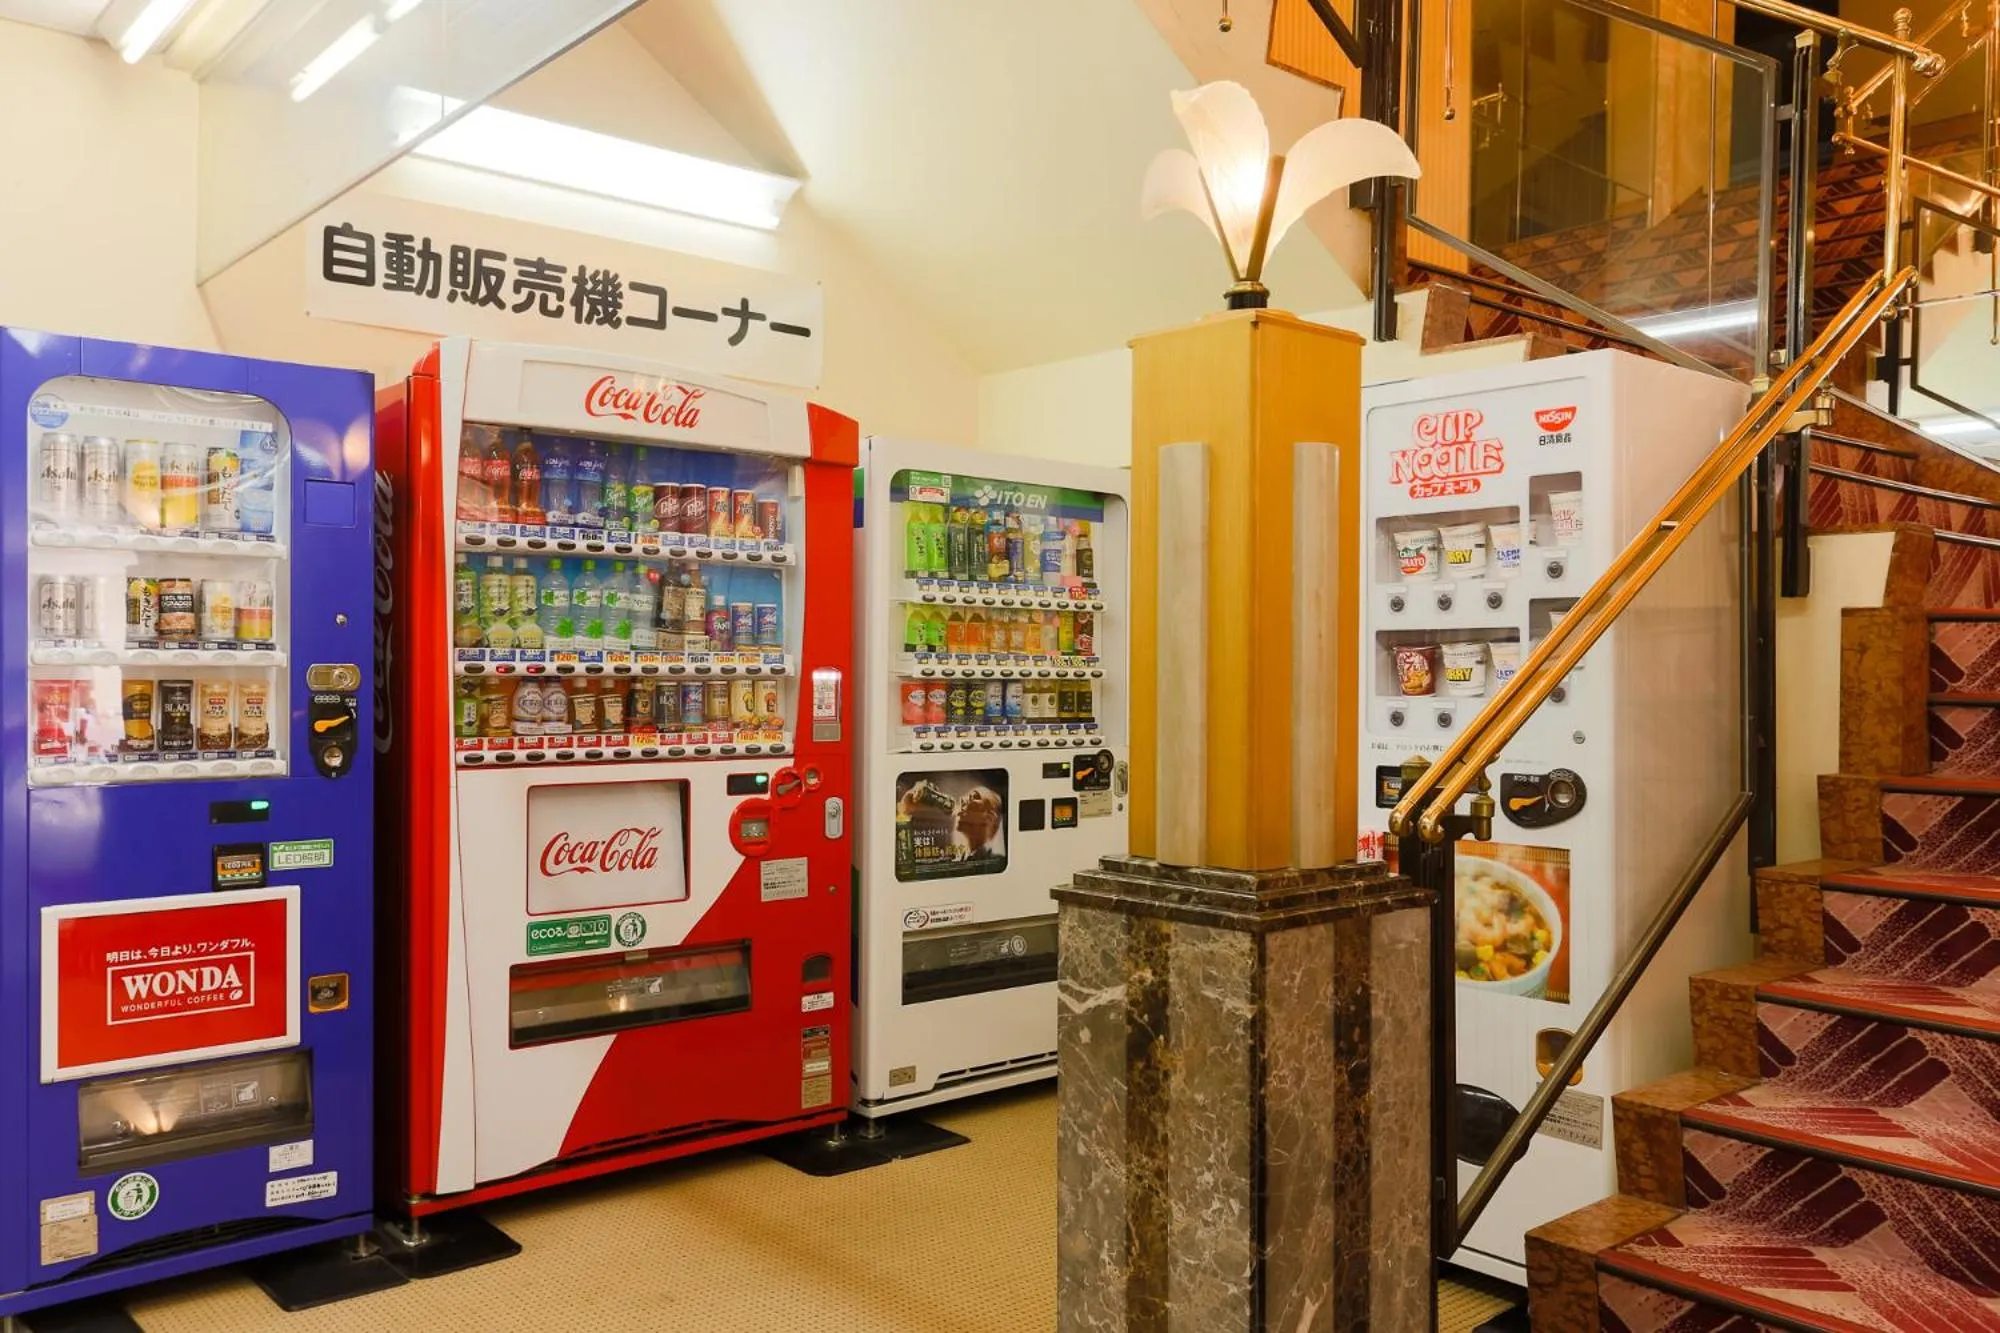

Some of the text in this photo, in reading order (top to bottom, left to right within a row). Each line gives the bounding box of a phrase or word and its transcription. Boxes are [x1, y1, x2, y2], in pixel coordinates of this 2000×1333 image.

[322, 222, 812, 347] 自動販売機コーナー
[584, 374, 707, 430] Coca-Cola
[1412, 408, 1484, 449] CUP
[1538, 410, 1573, 425] NISSIN
[1538, 433, 1573, 446] 日清食品
[996, 489, 1048, 510] ITO EN
[1413, 478, 1479, 499] カップヌードル
[540, 826, 663, 877] Coca-Cola
[122, 963, 243, 1001] WONDA
[120, 993, 225, 1013] WONDERFUL COFFEE
